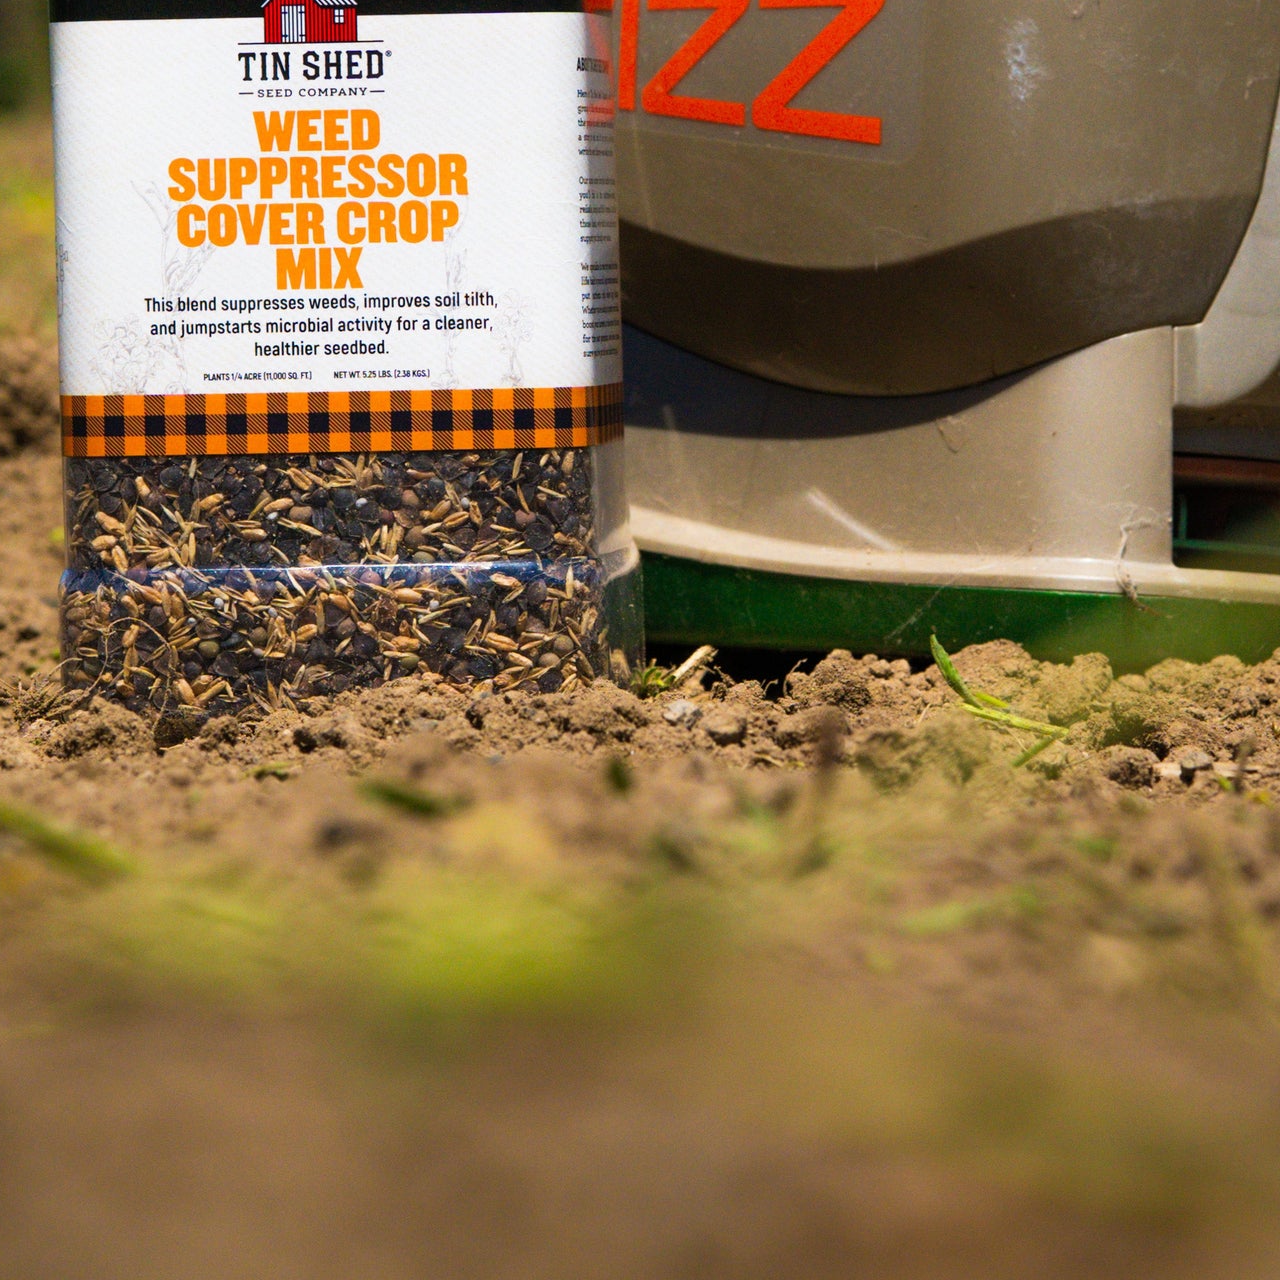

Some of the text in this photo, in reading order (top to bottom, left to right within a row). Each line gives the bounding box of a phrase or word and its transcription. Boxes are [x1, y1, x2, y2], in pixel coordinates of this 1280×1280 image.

[237, 51, 291, 82] TIN
[257, 87, 368, 98] SEED COMPANY
[253, 109, 380, 152] WEED
[168, 153, 469, 202] SUPPRESSOR
[176, 199, 460, 248] COVER CROP
[275, 246, 364, 291] MIX
[143, 291, 498, 314] This blend suppresses weeds, improves soil tilth,
[150, 315, 493, 339] and jumpstarts microbial activity for a cleaner,
[254, 339, 390, 357] healthier seedbed.
[204, 372, 230, 382] PLANTS
[231, 372, 243, 381] 1/4
[244, 372, 262, 381] ACRE
[334, 370, 348, 379] NET
[363, 370, 377, 379] 5.25
